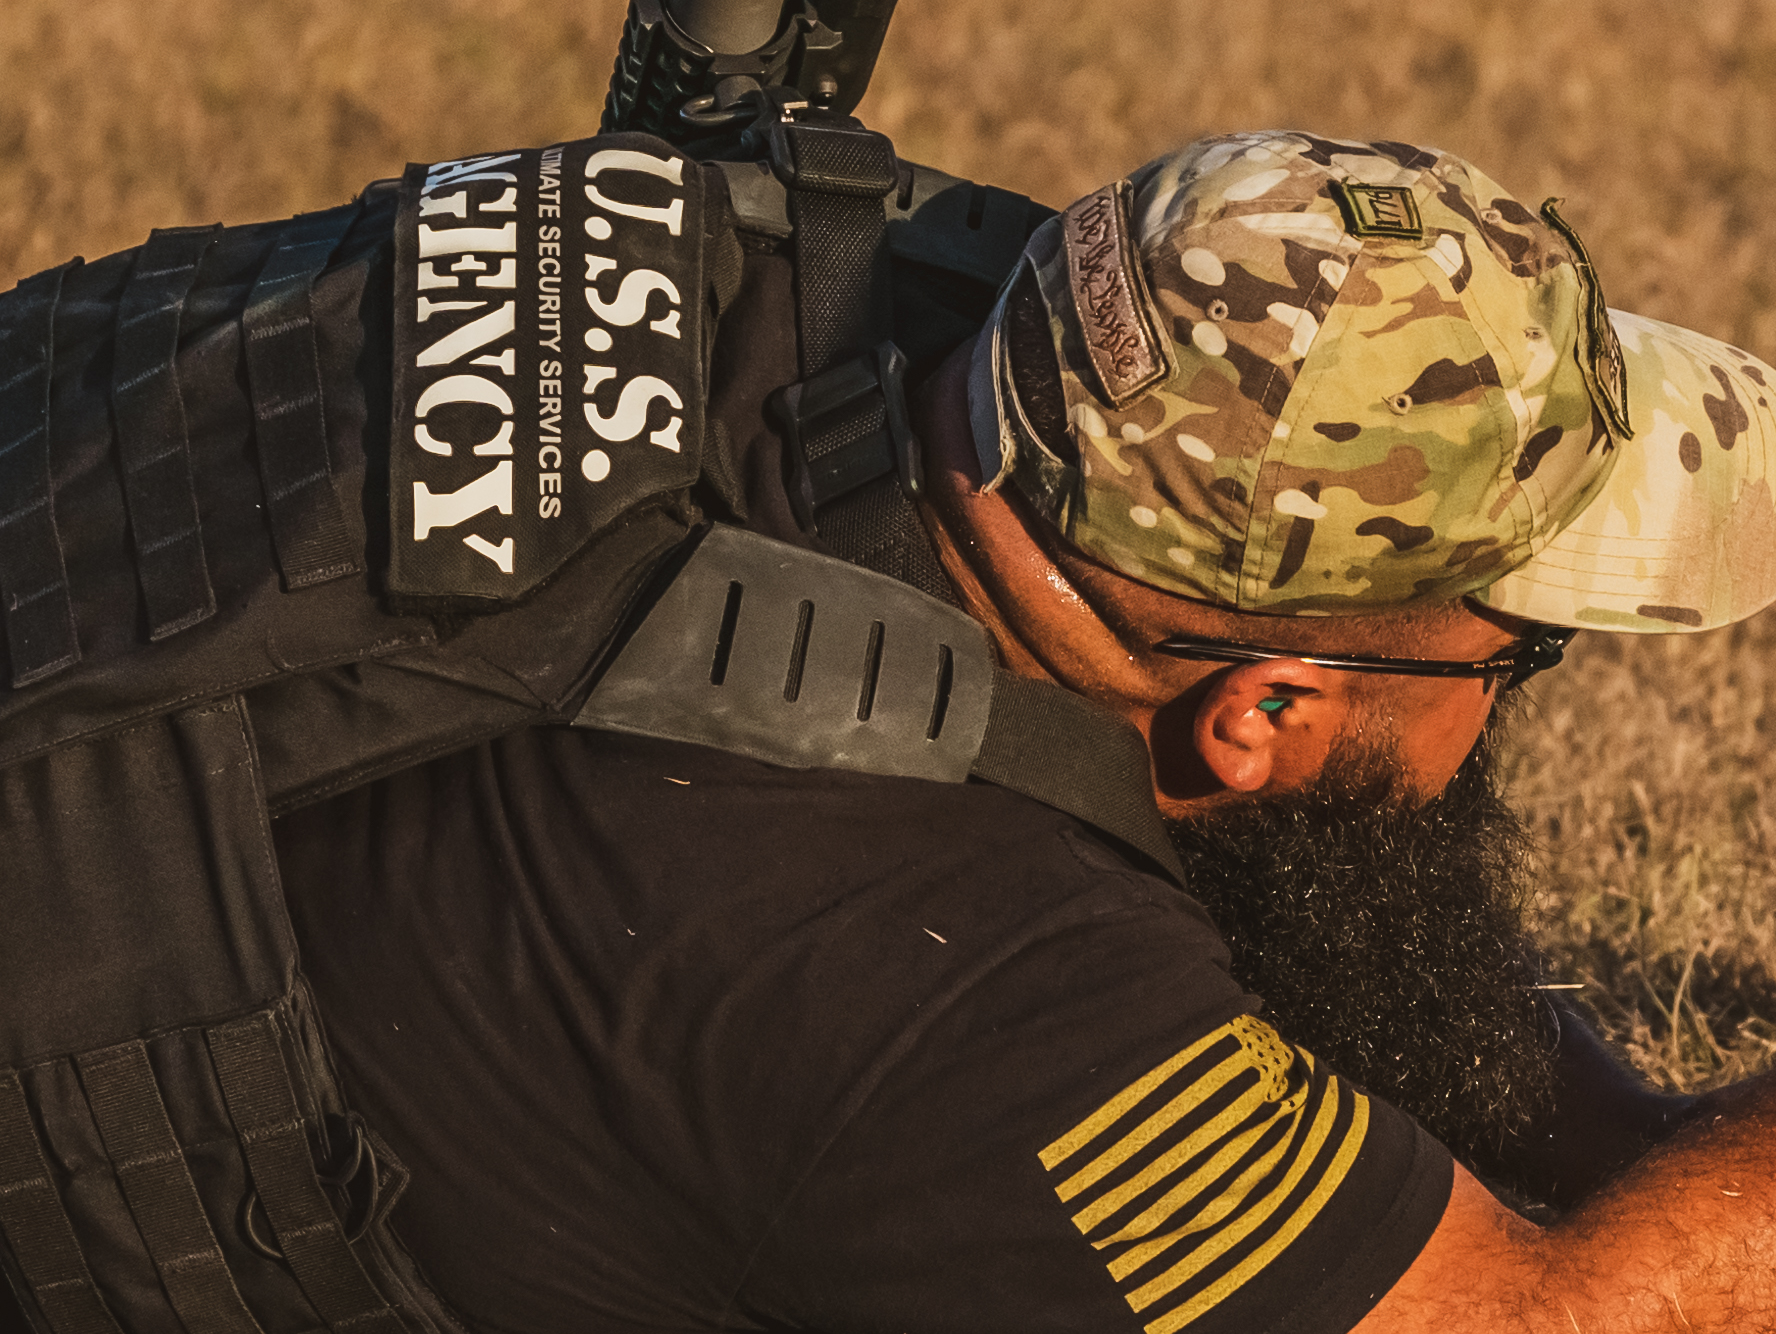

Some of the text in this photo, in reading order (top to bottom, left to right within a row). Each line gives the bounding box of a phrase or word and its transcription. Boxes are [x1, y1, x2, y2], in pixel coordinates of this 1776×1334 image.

[537, 224, 562, 353] SECURITY
[1364, 190, 1403, 228] 1776
[413, 153, 522, 575] AGENCY
[581, 149, 685, 483] U.S.S.
[538, 359, 563, 519] SERVICES
